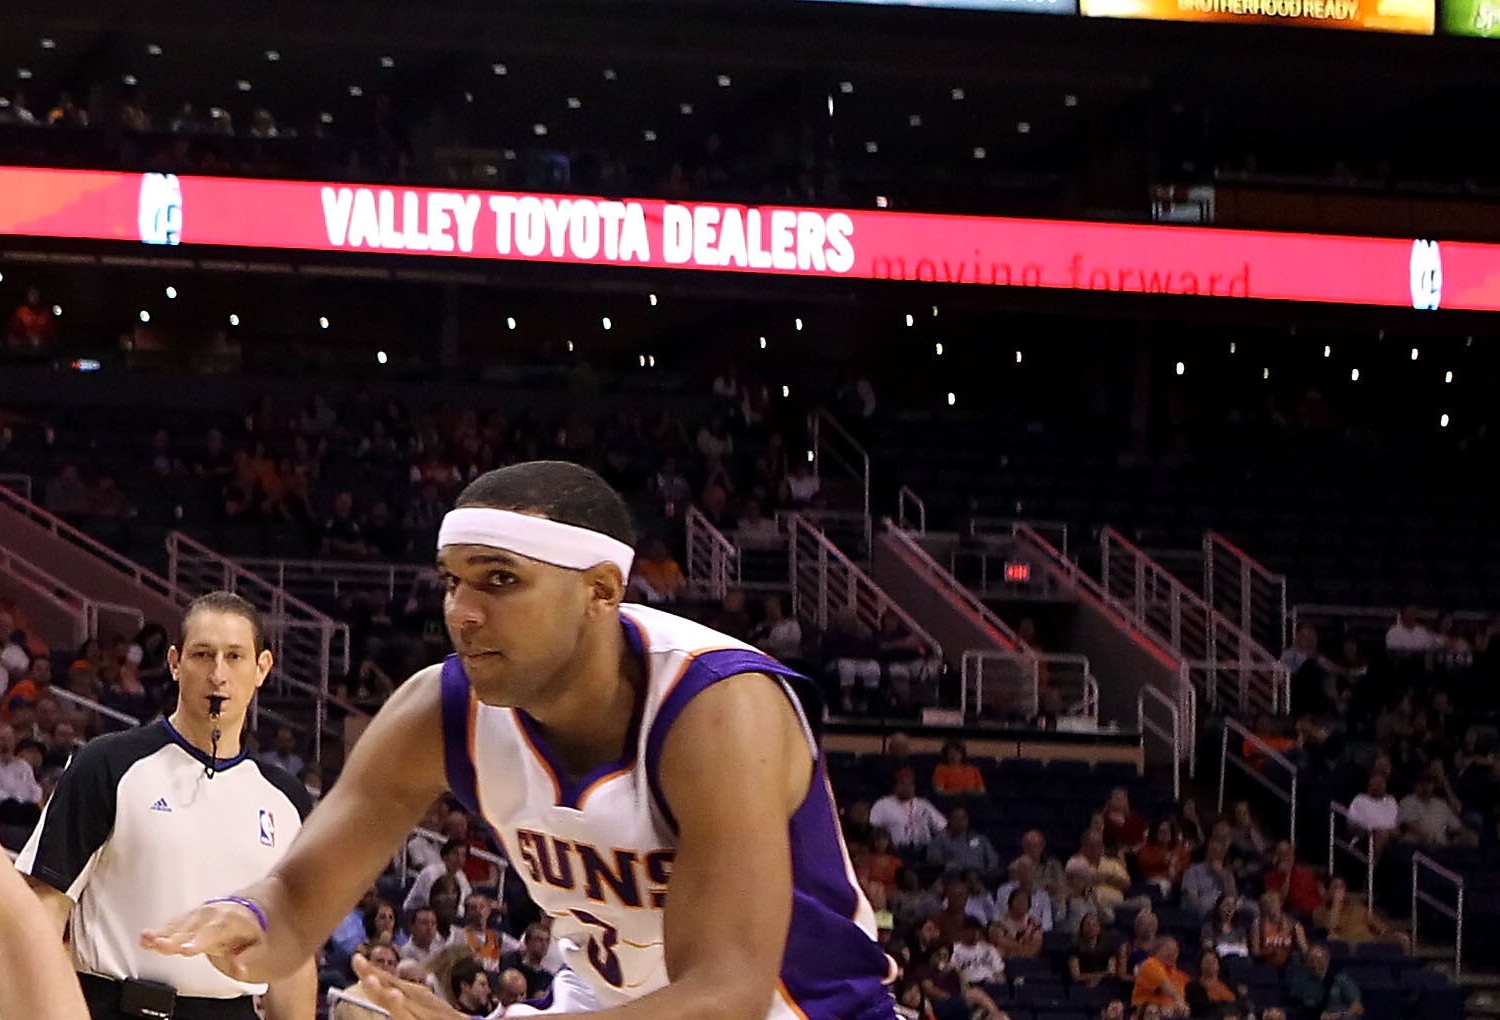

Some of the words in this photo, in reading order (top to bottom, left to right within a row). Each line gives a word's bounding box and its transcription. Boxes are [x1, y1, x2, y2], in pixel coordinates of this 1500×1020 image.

[1303, 0, 1359, 20] READY
[321, 186, 481, 253] VALLEY
[490, 194, 650, 263] TOYOTA
[663, 203, 855, 273] DEALERS
[1068, 252, 1250, 298] forward
[516, 828, 676, 910] SUNS
